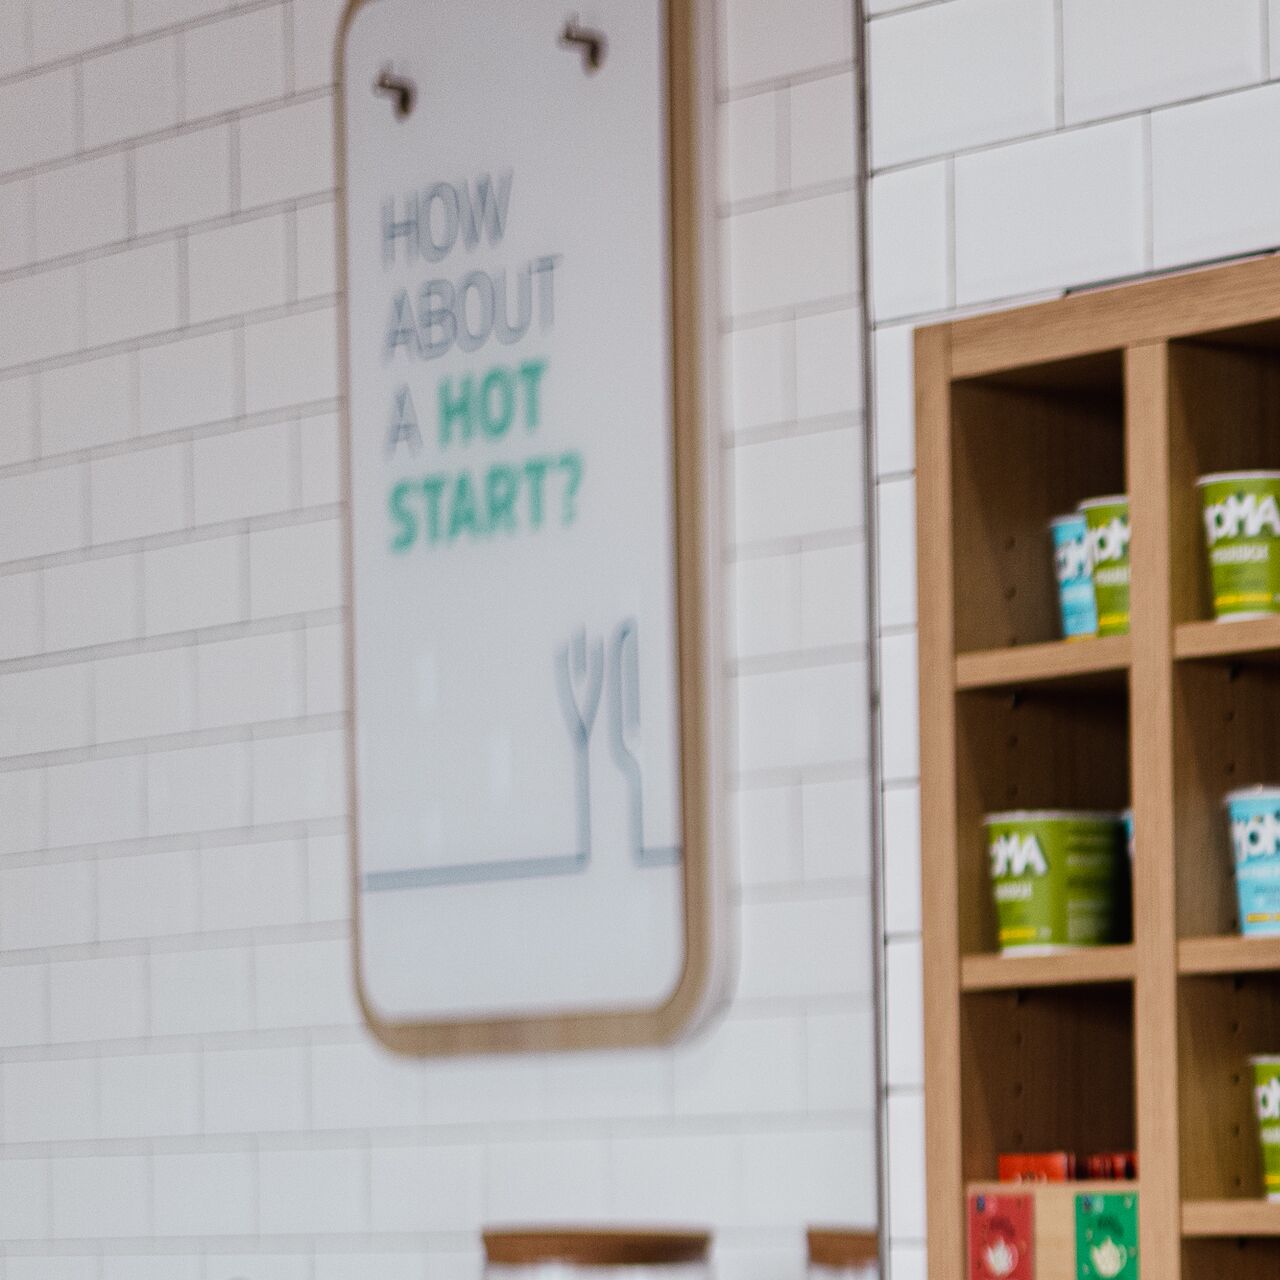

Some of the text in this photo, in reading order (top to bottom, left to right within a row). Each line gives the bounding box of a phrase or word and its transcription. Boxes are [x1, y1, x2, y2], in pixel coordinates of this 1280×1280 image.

[382, 171, 513, 267] HOW
[383, 254, 562, 362] ABOUT
[386, 357, 548, 457] A HOT
[388, 450, 584, 553] START?
